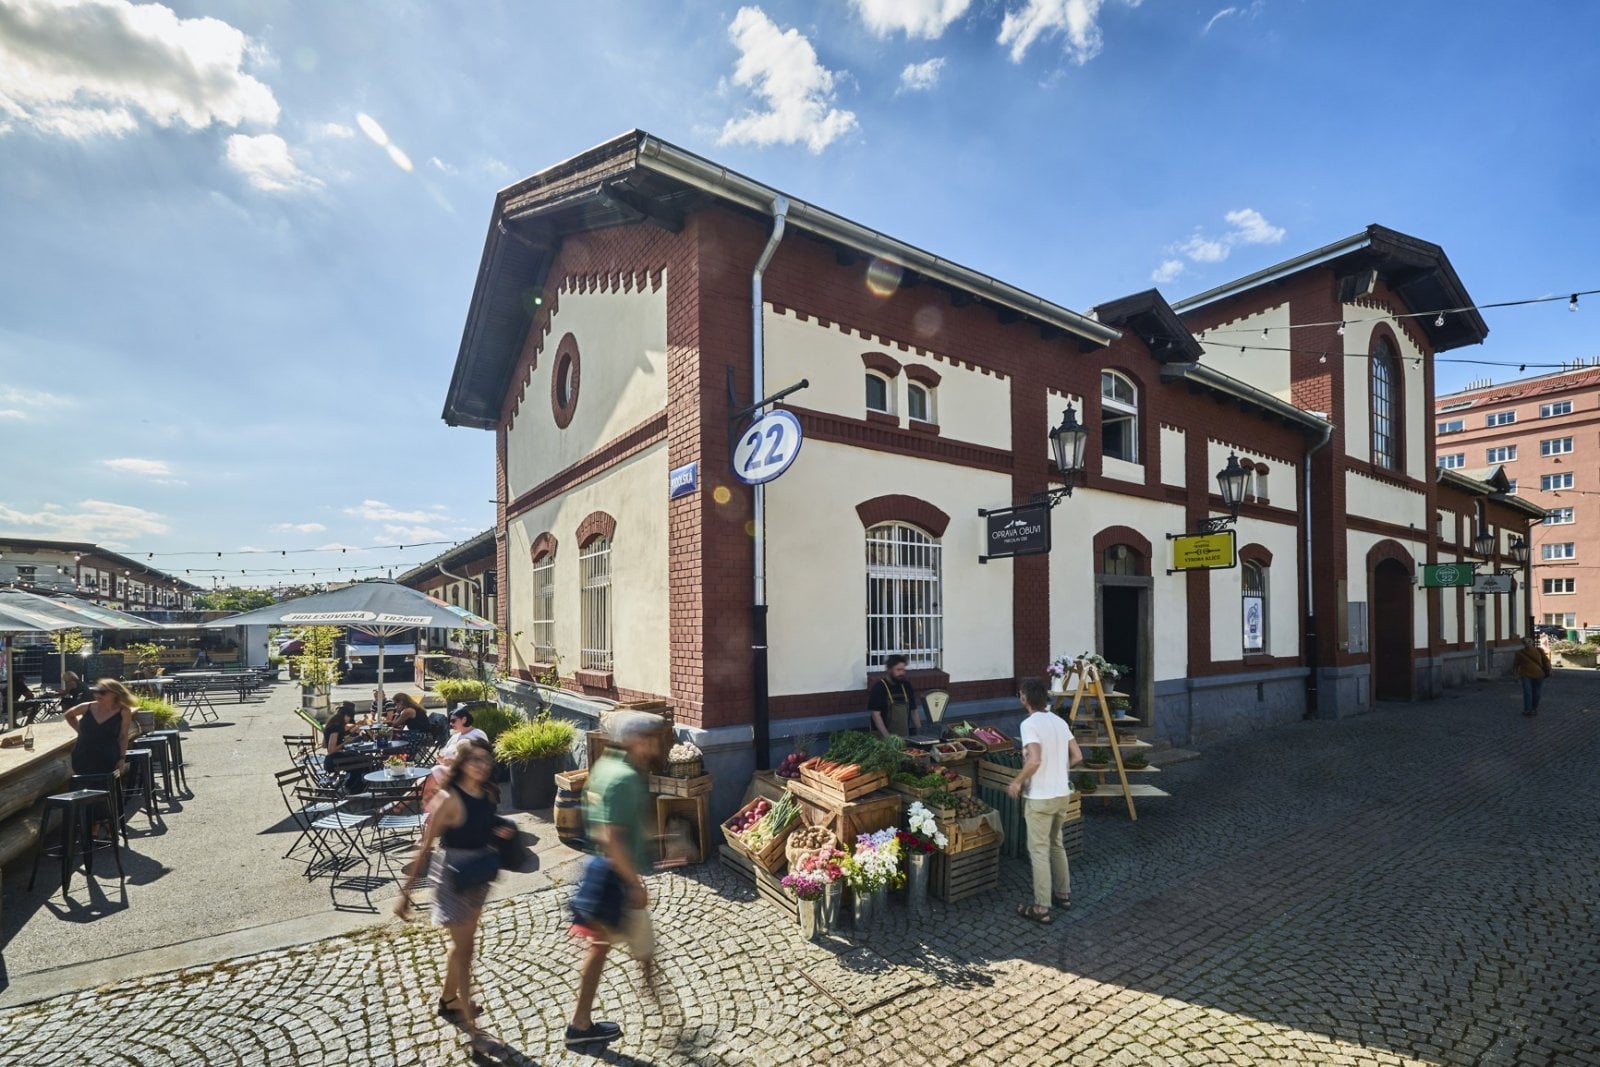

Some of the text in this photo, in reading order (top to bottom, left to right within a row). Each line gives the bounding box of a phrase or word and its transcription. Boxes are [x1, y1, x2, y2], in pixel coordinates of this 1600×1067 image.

[744, 423, 784, 472] 22
[991, 528, 1018, 540] OPRAVA
[1019, 524, 1041, 536] OBUVI
